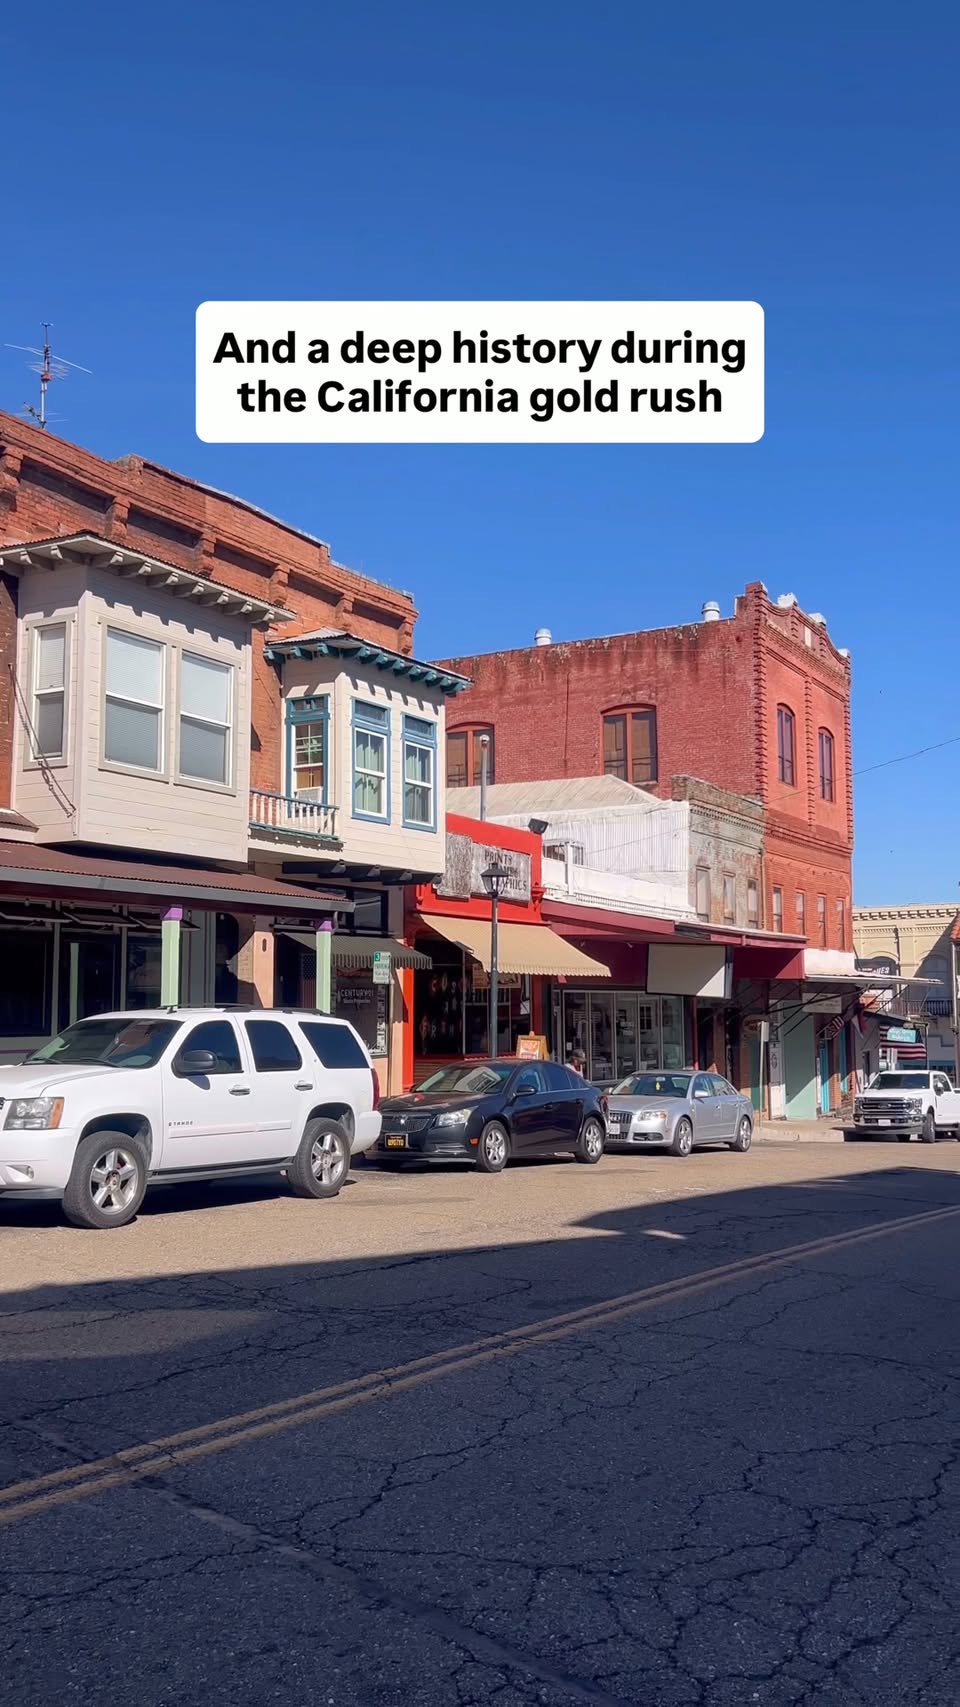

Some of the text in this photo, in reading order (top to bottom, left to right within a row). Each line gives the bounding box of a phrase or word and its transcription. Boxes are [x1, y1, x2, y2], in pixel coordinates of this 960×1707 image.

[485, 849, 513, 866] PRINTS
[375, 953, 380, 961] 3
[341, 988, 367, 998] CENTURY
